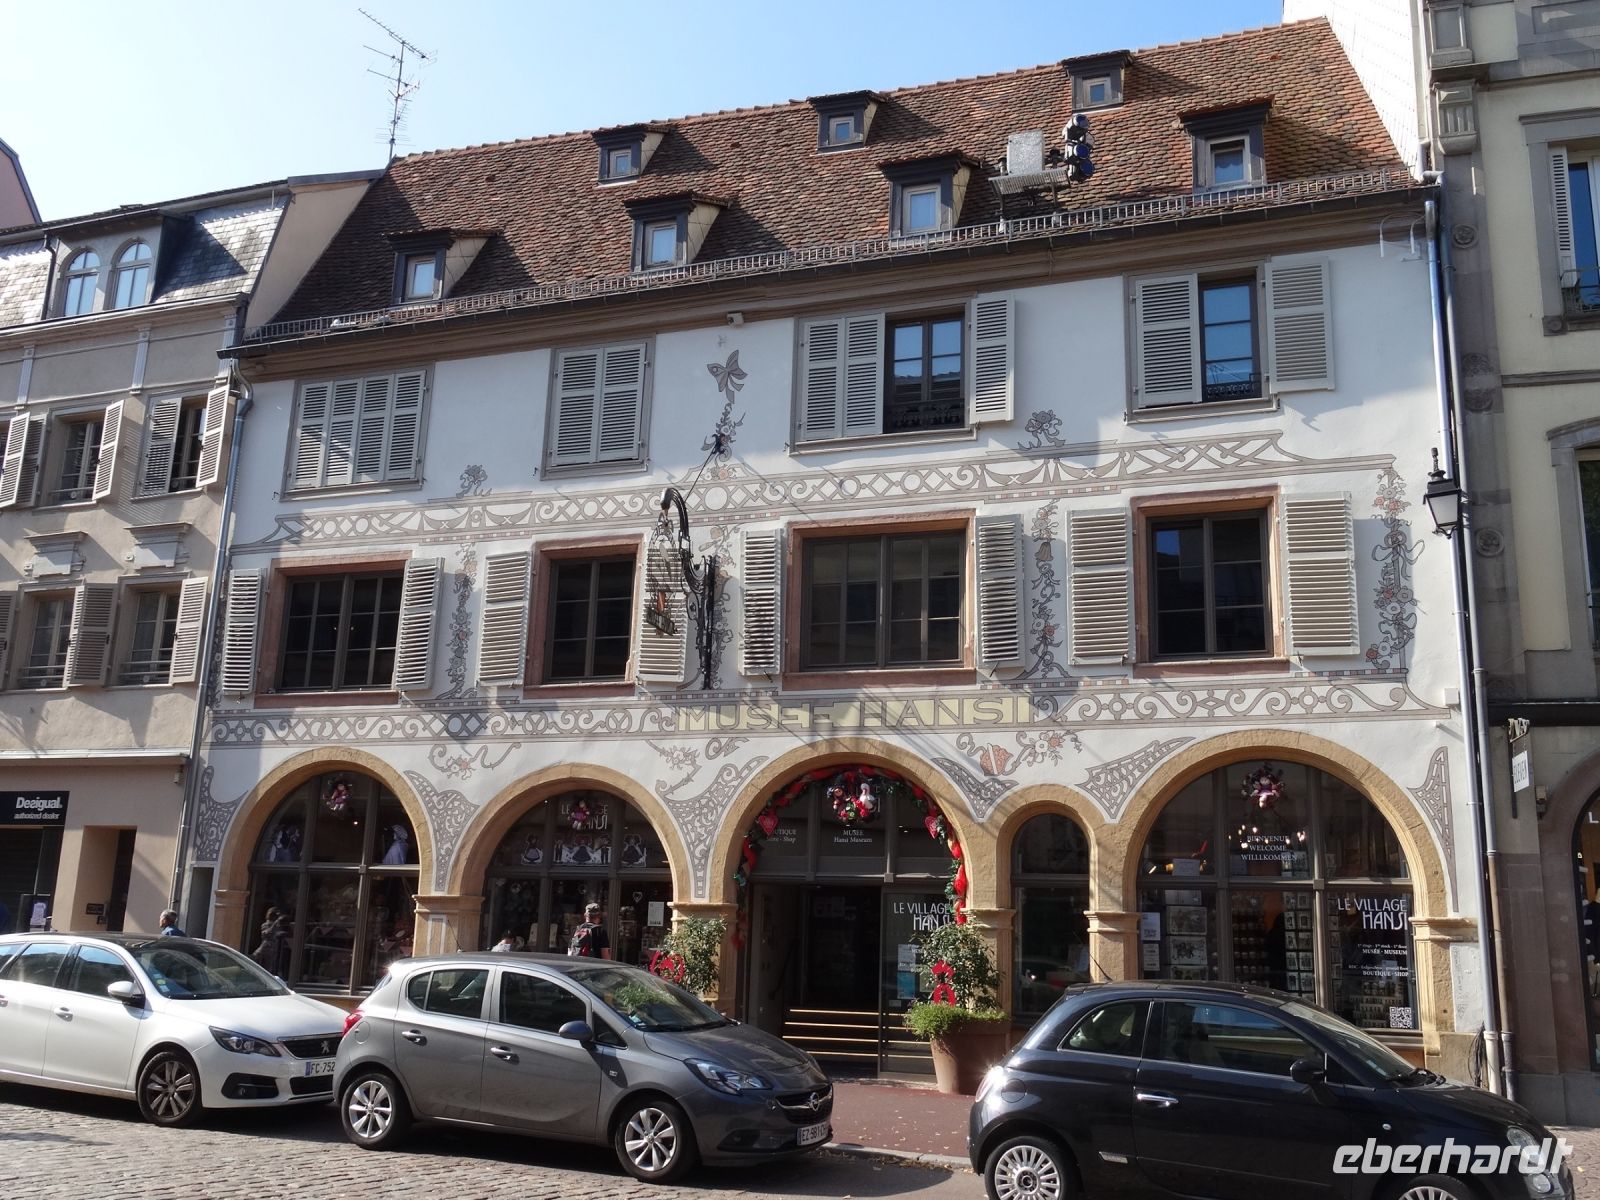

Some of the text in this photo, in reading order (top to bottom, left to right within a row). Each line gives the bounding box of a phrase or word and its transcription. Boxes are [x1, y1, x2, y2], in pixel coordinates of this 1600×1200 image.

[860, 697, 1019, 728] HANSI
[893, 902, 950, 915] LE VILLAGE
[1338, 898, 1407, 912] LE VILLAGE
[1362, 911, 1408, 930] HANSI
